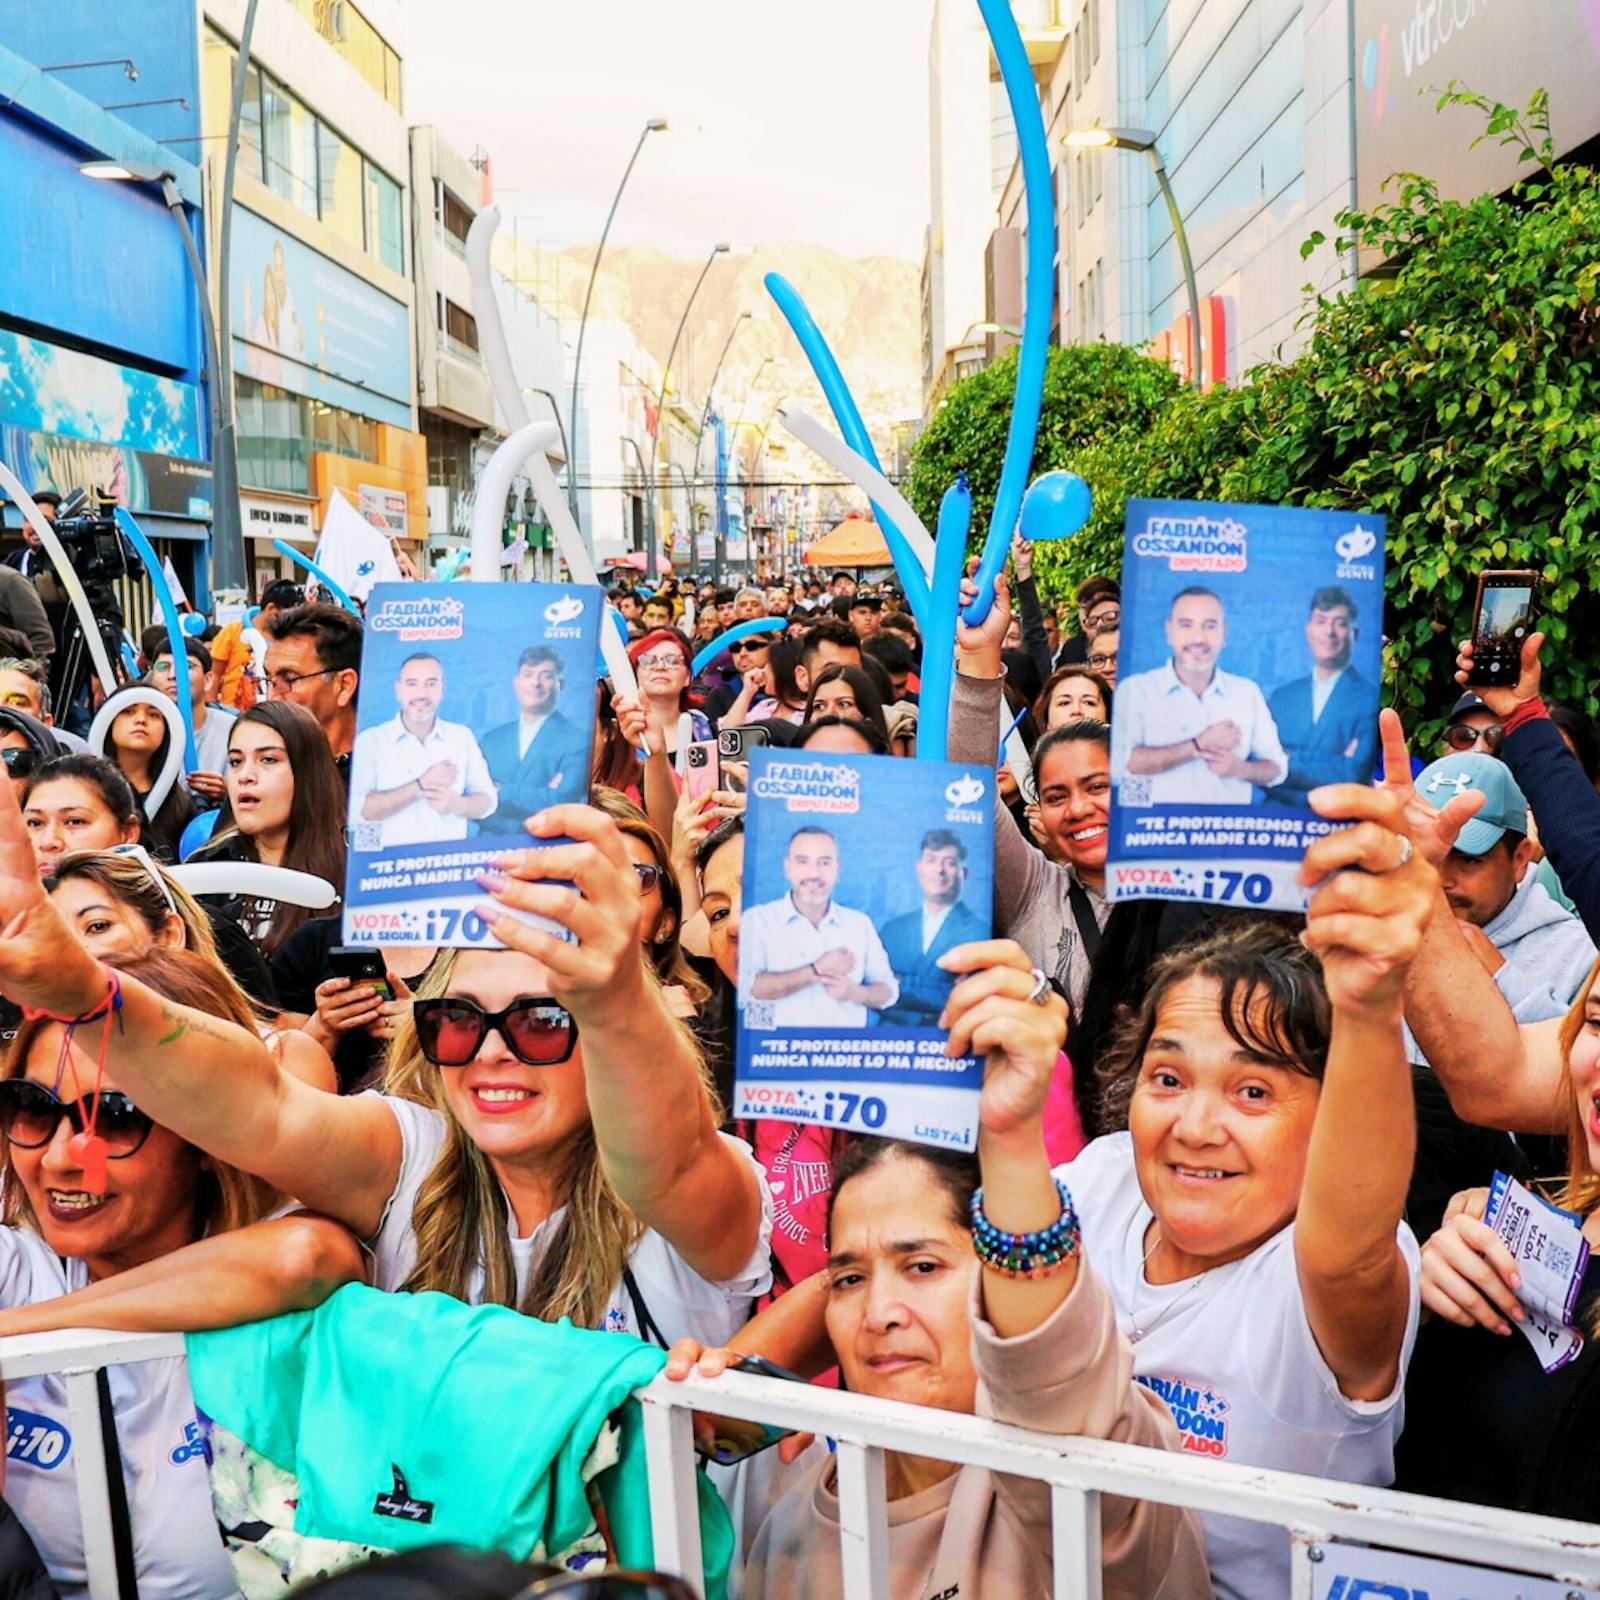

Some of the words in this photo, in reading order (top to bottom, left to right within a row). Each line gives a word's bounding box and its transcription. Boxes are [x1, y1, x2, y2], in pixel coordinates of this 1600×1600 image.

[1168, 817, 1303, 834] PROTEGEREMOS
[1126, 832, 1188, 847] NUNCA
[1190, 832, 1246, 846] NADIE
[1249, 833, 1271, 847] LO
[1273, 834, 1299, 848] HA
[360, 875, 412, 892] NUNCA
[415, 870, 463, 886] NADIE
[1115, 868, 1173, 884] VOTA
[1116, 886, 1124, 897] A
[1126, 885, 1141, 895] LA
[1145, 885, 1197, 897] SEGURA
[1202, 870, 1273, 904] i70
[352, 913, 401, 929] VOTA
[426, 909, 488, 942] i70
[351, 931, 359, 941] A
[361, 931, 374, 941] LA
[378, 930, 421, 941] SEGURA
[791, 1040, 915, 1054] PROTEGEREMOS
[752, 1054, 809, 1068] NUNCA
[811, 1055, 862, 1069] NADIE
[864, 1056, 886, 1069] LO
[888, 1056, 911, 1070] HA
[743, 1087, 798, 1105] VOTA
[742, 1103, 751, 1113] A
[753, 1103, 767, 1114] LA
[772, 1105, 819, 1120] SEGURA
[824, 1091, 888, 1129] i70
[1523, 1224, 1539, 1260] VOTA
